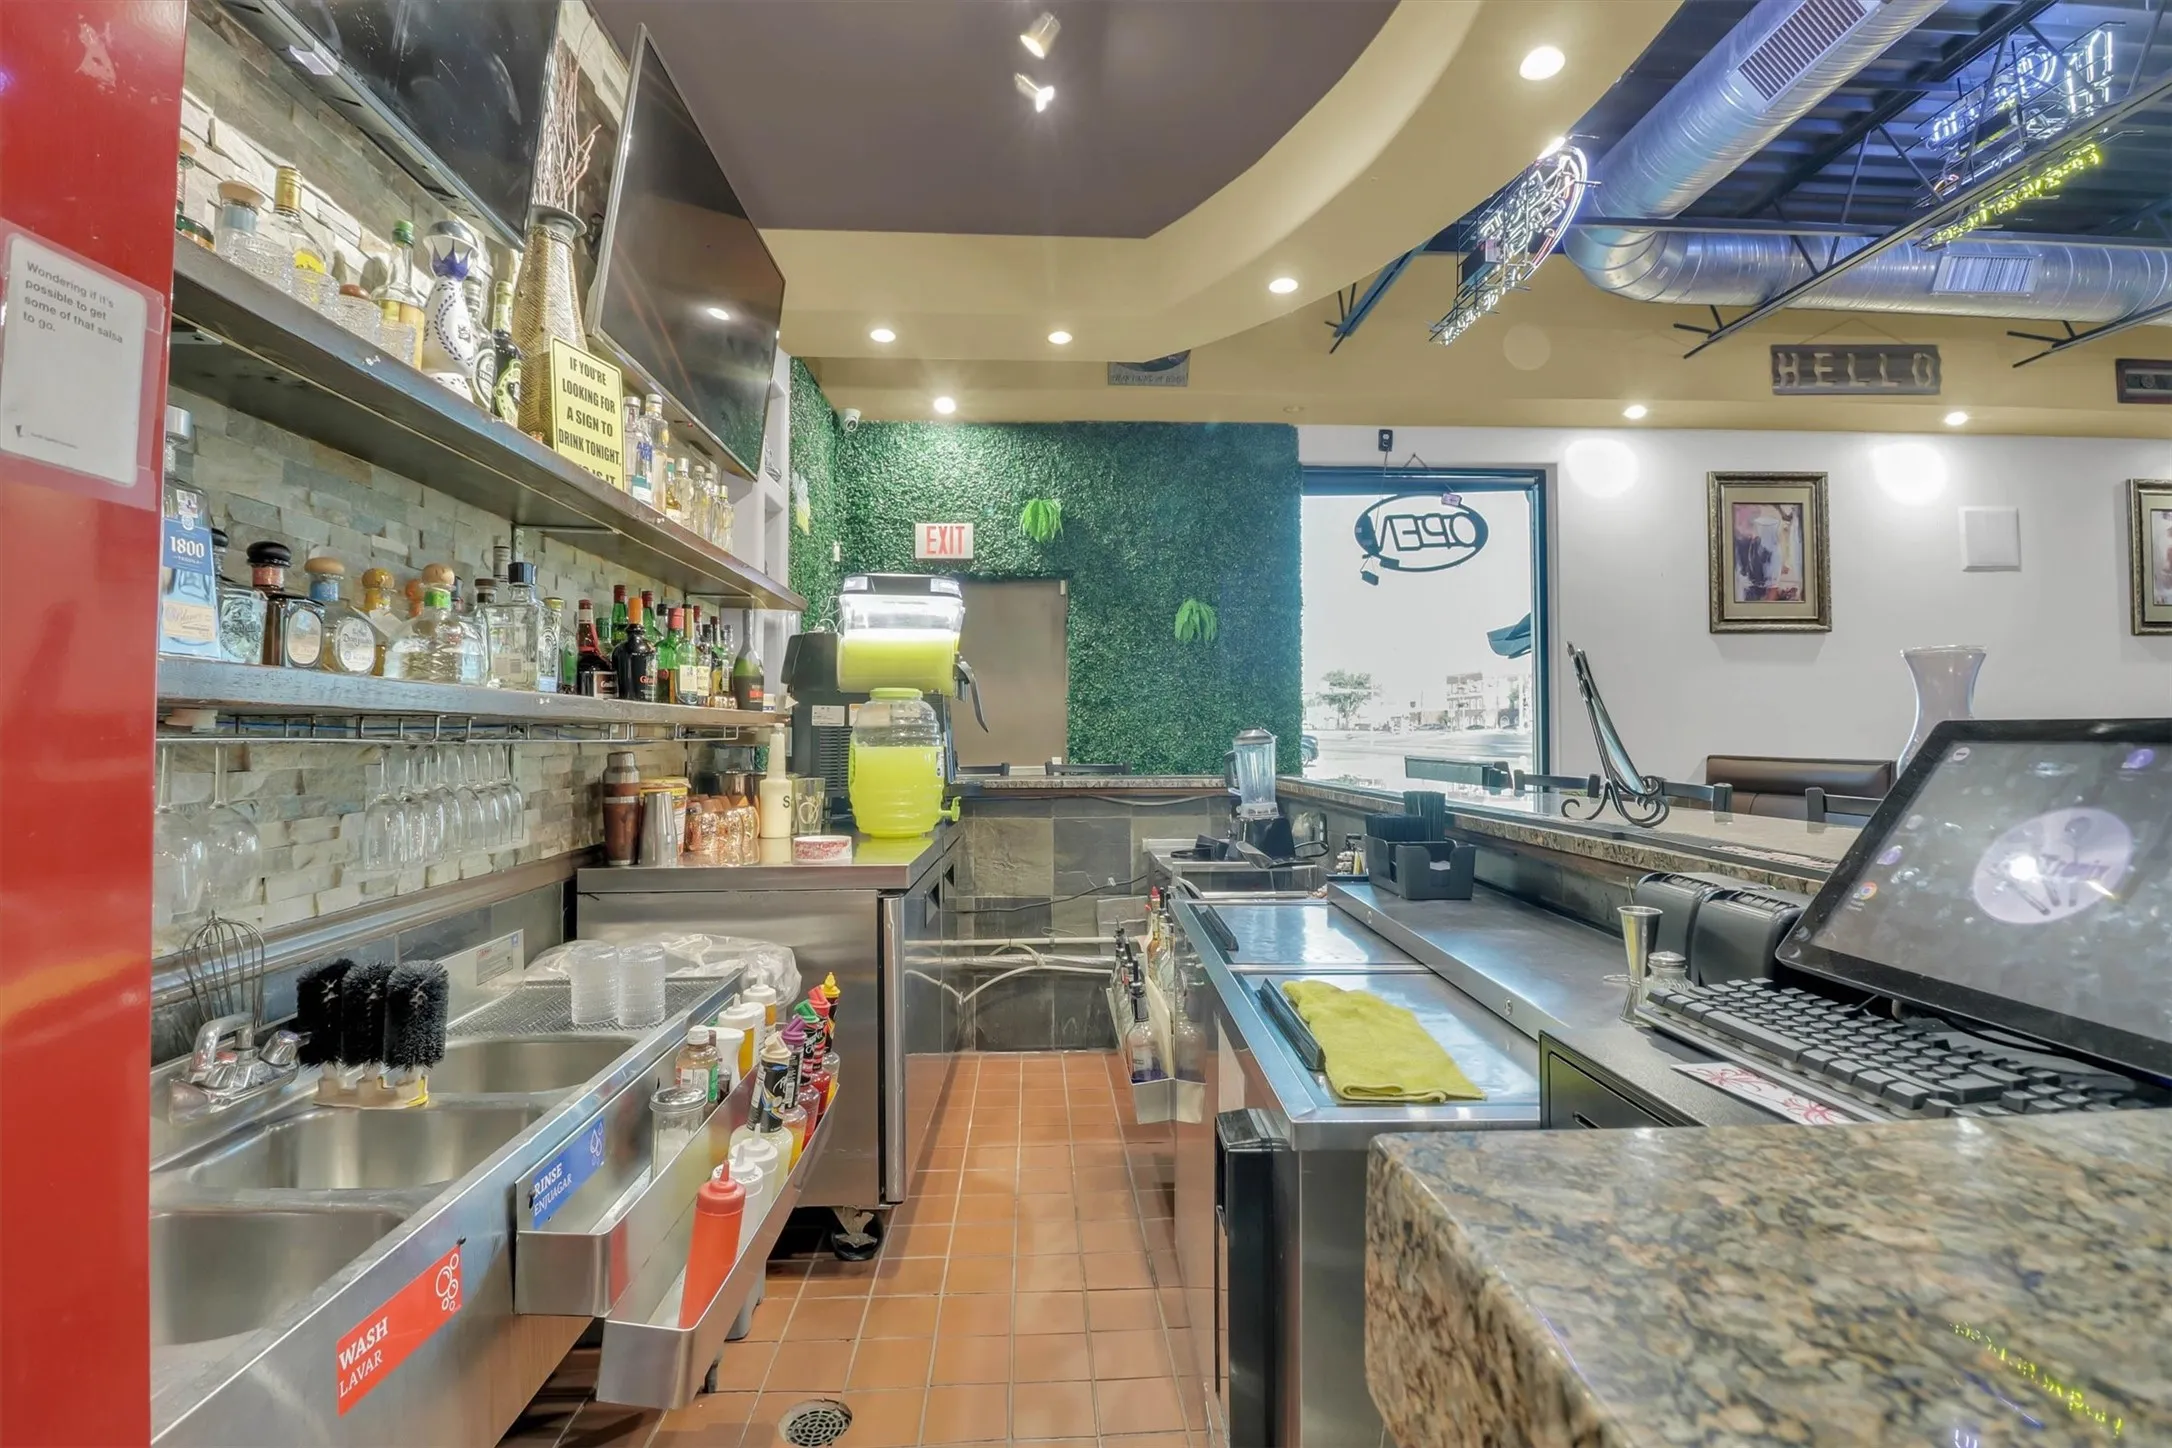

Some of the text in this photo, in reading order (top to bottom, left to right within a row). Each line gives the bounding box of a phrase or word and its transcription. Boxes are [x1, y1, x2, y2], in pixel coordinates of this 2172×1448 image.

[25, 280, 107, 322] possible to get
[26, 260, 114, 309] Wondering if it's
[23, 310, 56, 332] to go.
[24, 295, 123, 344] some of that salsa
[569, 356, 607, 386] IF YOU'RE
[1777, 352, 1935, 387] HELLO
[562, 378, 616, 415] LOOKING FOR
[566, 406, 613, 438] A SIGN TO
[558, 428, 584, 453] DRINK
[170, 535, 205, 559] 1800
[926, 525, 965, 555] EXIT
[783, 795, 790, 808] S
[534, 1162, 563, 1195] RINSE
[534, 1173, 573, 1216] ENJUAGAR
[338, 1316, 389, 1370] WASH
[339, 1349, 383, 1398] LAVAR
